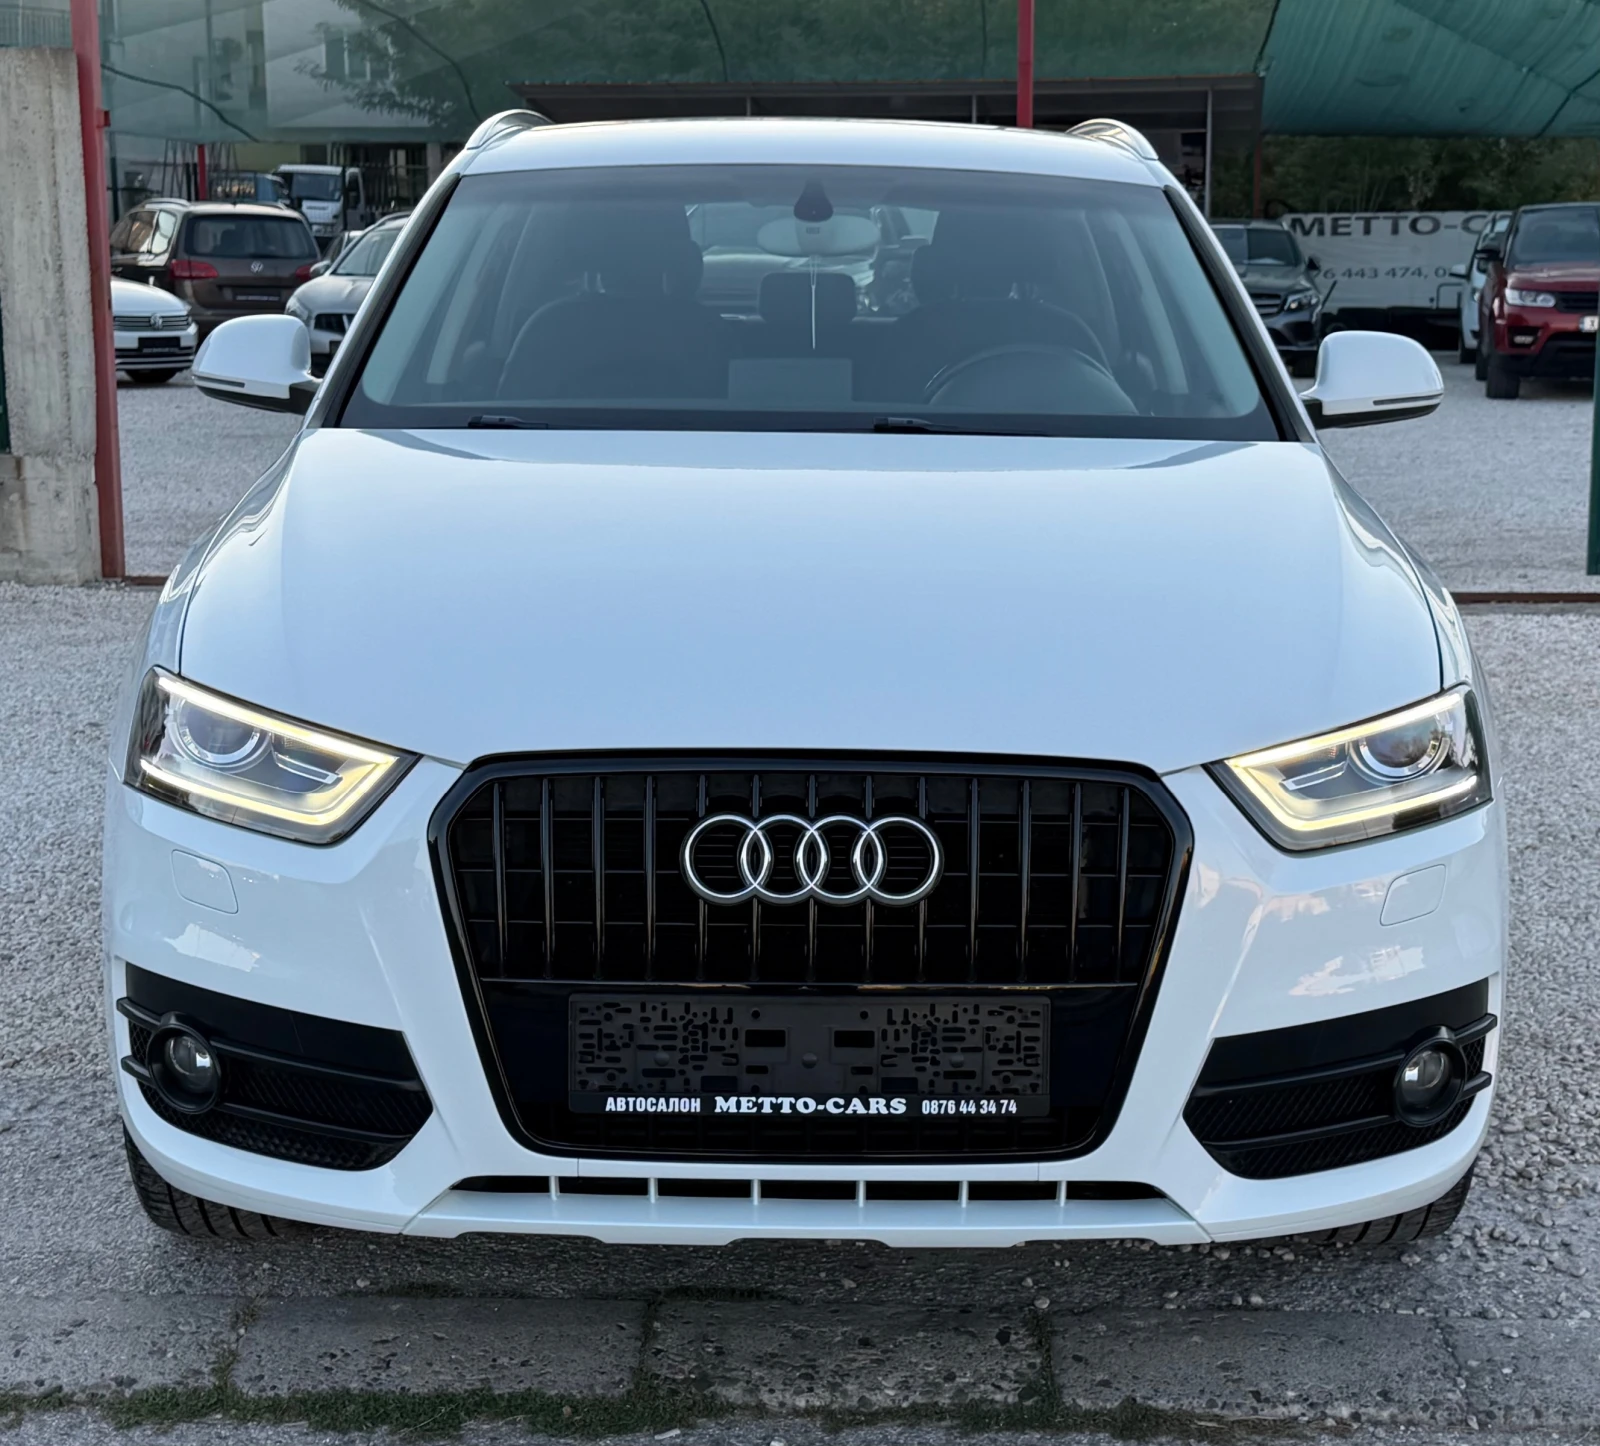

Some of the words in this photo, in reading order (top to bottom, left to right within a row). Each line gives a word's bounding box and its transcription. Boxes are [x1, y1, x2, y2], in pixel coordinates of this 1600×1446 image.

[1341, 267, 1379, 280] 443
[605, 1097, 701, 1113] АВТОСАЛОН
[714, 1096, 907, 1114] METTO-CARS
[922, 1099, 956, 1115] 0876
[959, 1100, 976, 1115] 44
[979, 1100, 997, 1115] 34
[1000, 1100, 1018, 1115] 74
